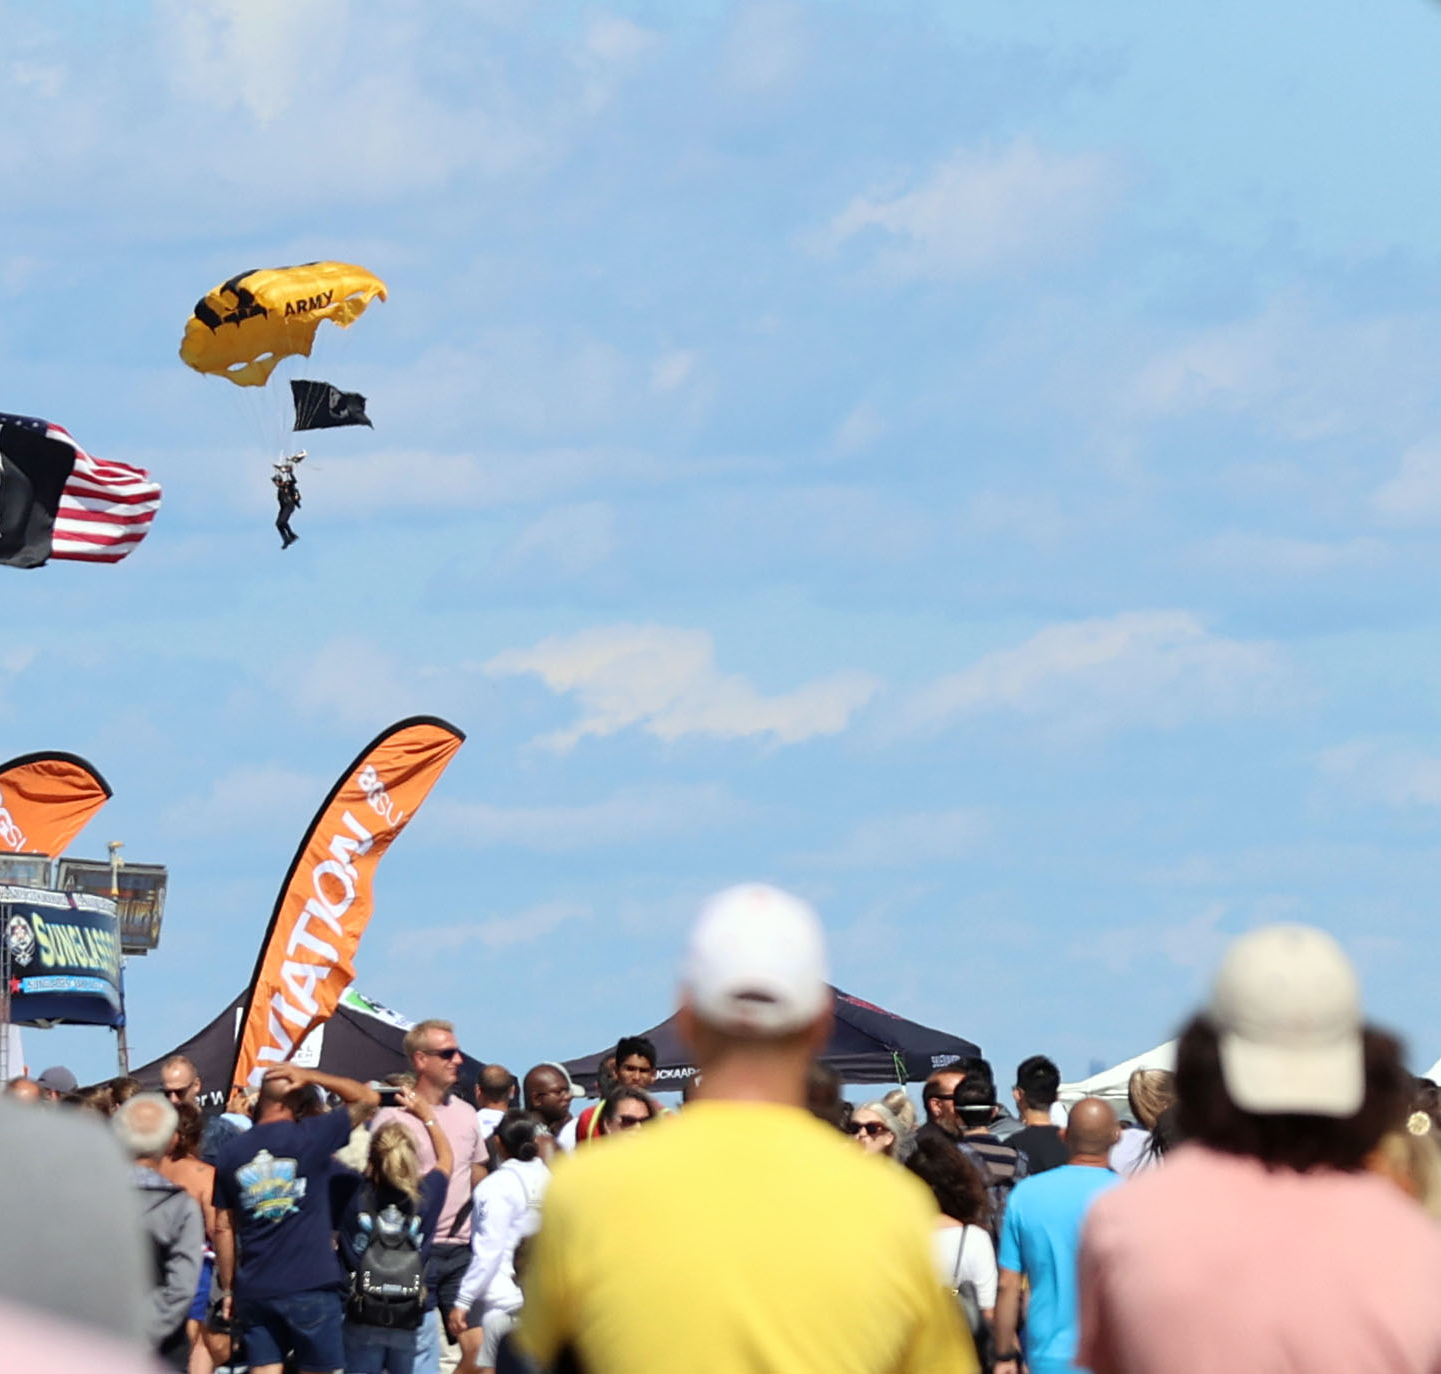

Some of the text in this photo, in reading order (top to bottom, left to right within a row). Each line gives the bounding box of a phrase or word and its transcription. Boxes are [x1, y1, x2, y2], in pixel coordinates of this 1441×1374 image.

[284, 289, 334, 318] ARMY
[357, 764, 405, 828] BGSU
[247, 809, 374, 1088] VIATION
